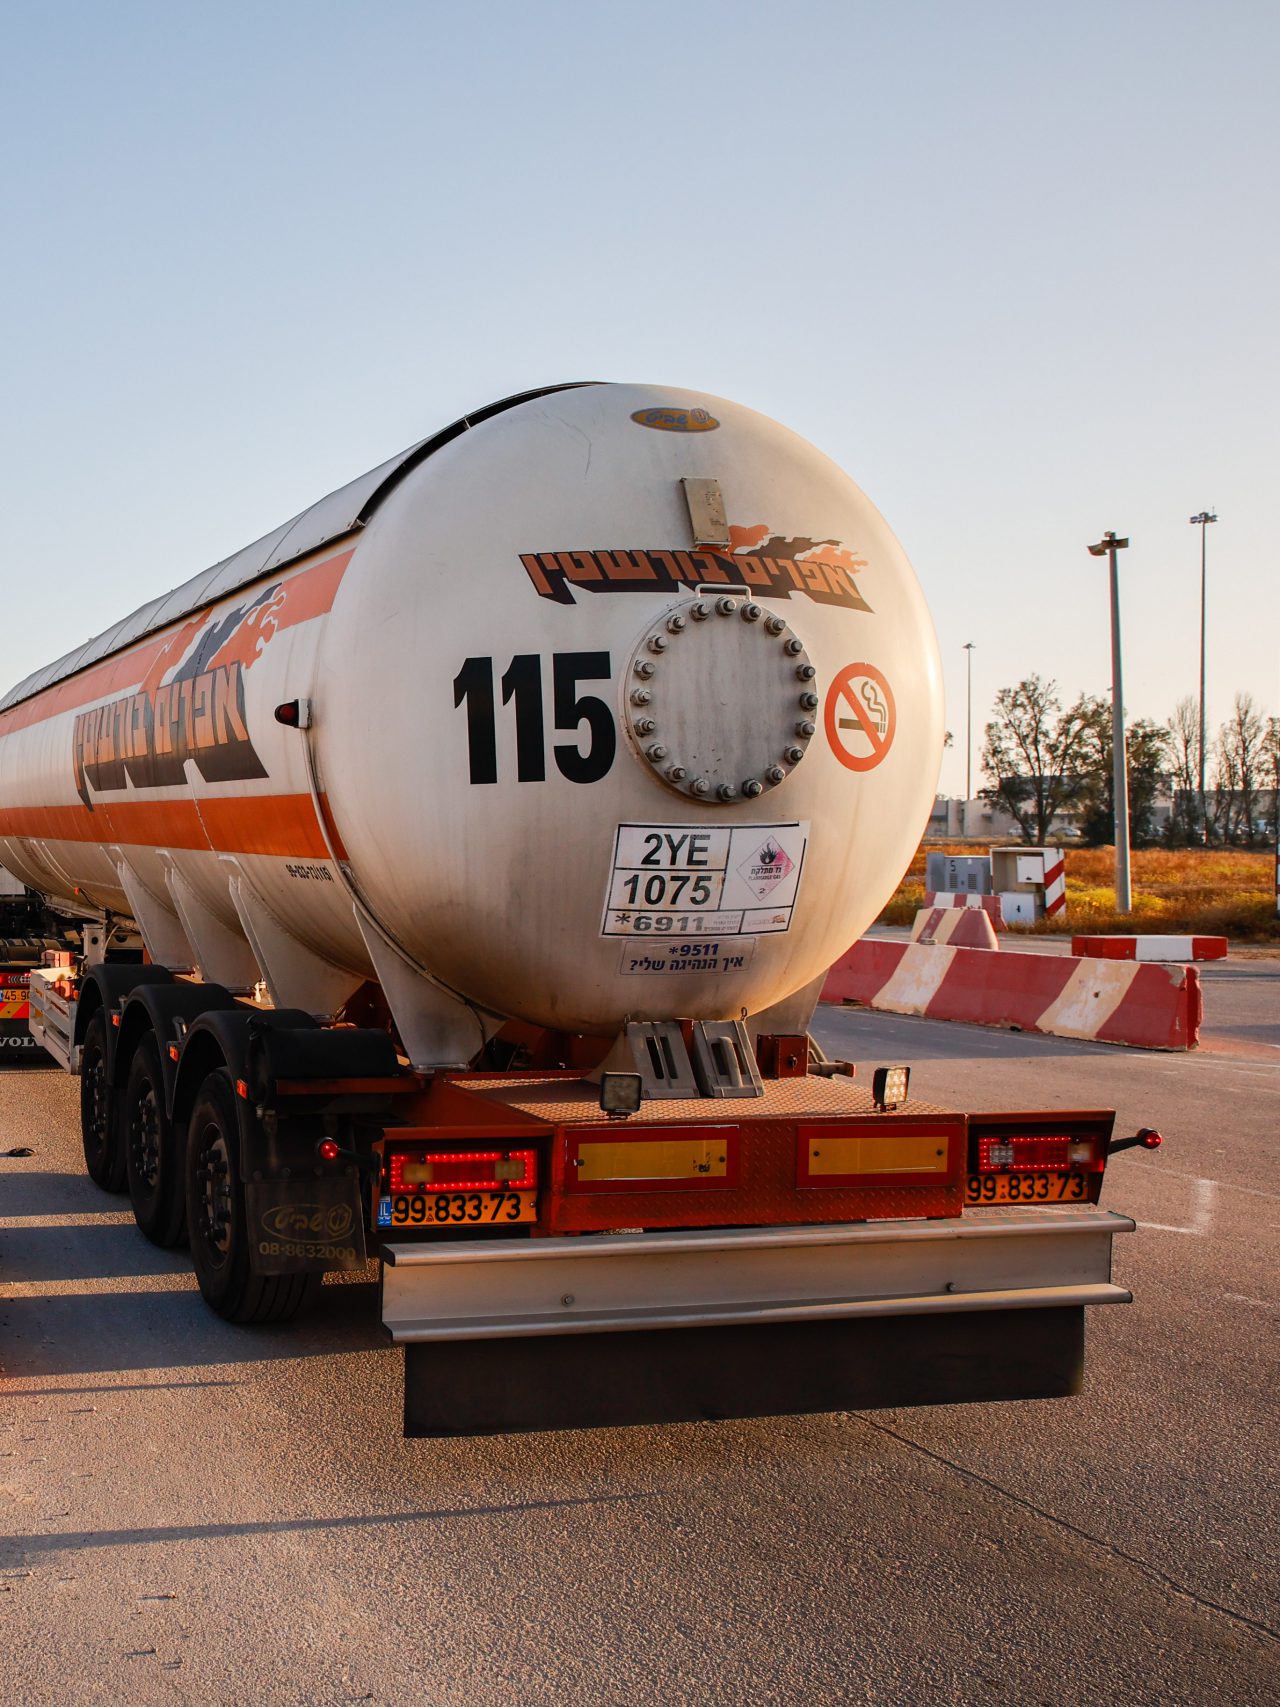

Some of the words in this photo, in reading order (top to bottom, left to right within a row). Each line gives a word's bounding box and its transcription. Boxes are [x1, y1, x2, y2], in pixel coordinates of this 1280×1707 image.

[519, 549, 730, 596] בורשטין
[731, 552, 863, 600] אפרים
[153, 662, 249, 755] אפרים
[453, 651, 616, 785] 115
[640, 833, 711, 866] 2YE
[950, 860, 956, 872] 5
[623, 873, 713, 906] 1075
[629, 957, 666, 971] שלי?
[669, 958, 718, 971] הנהיגה
[723, 956, 744, 971] איך
